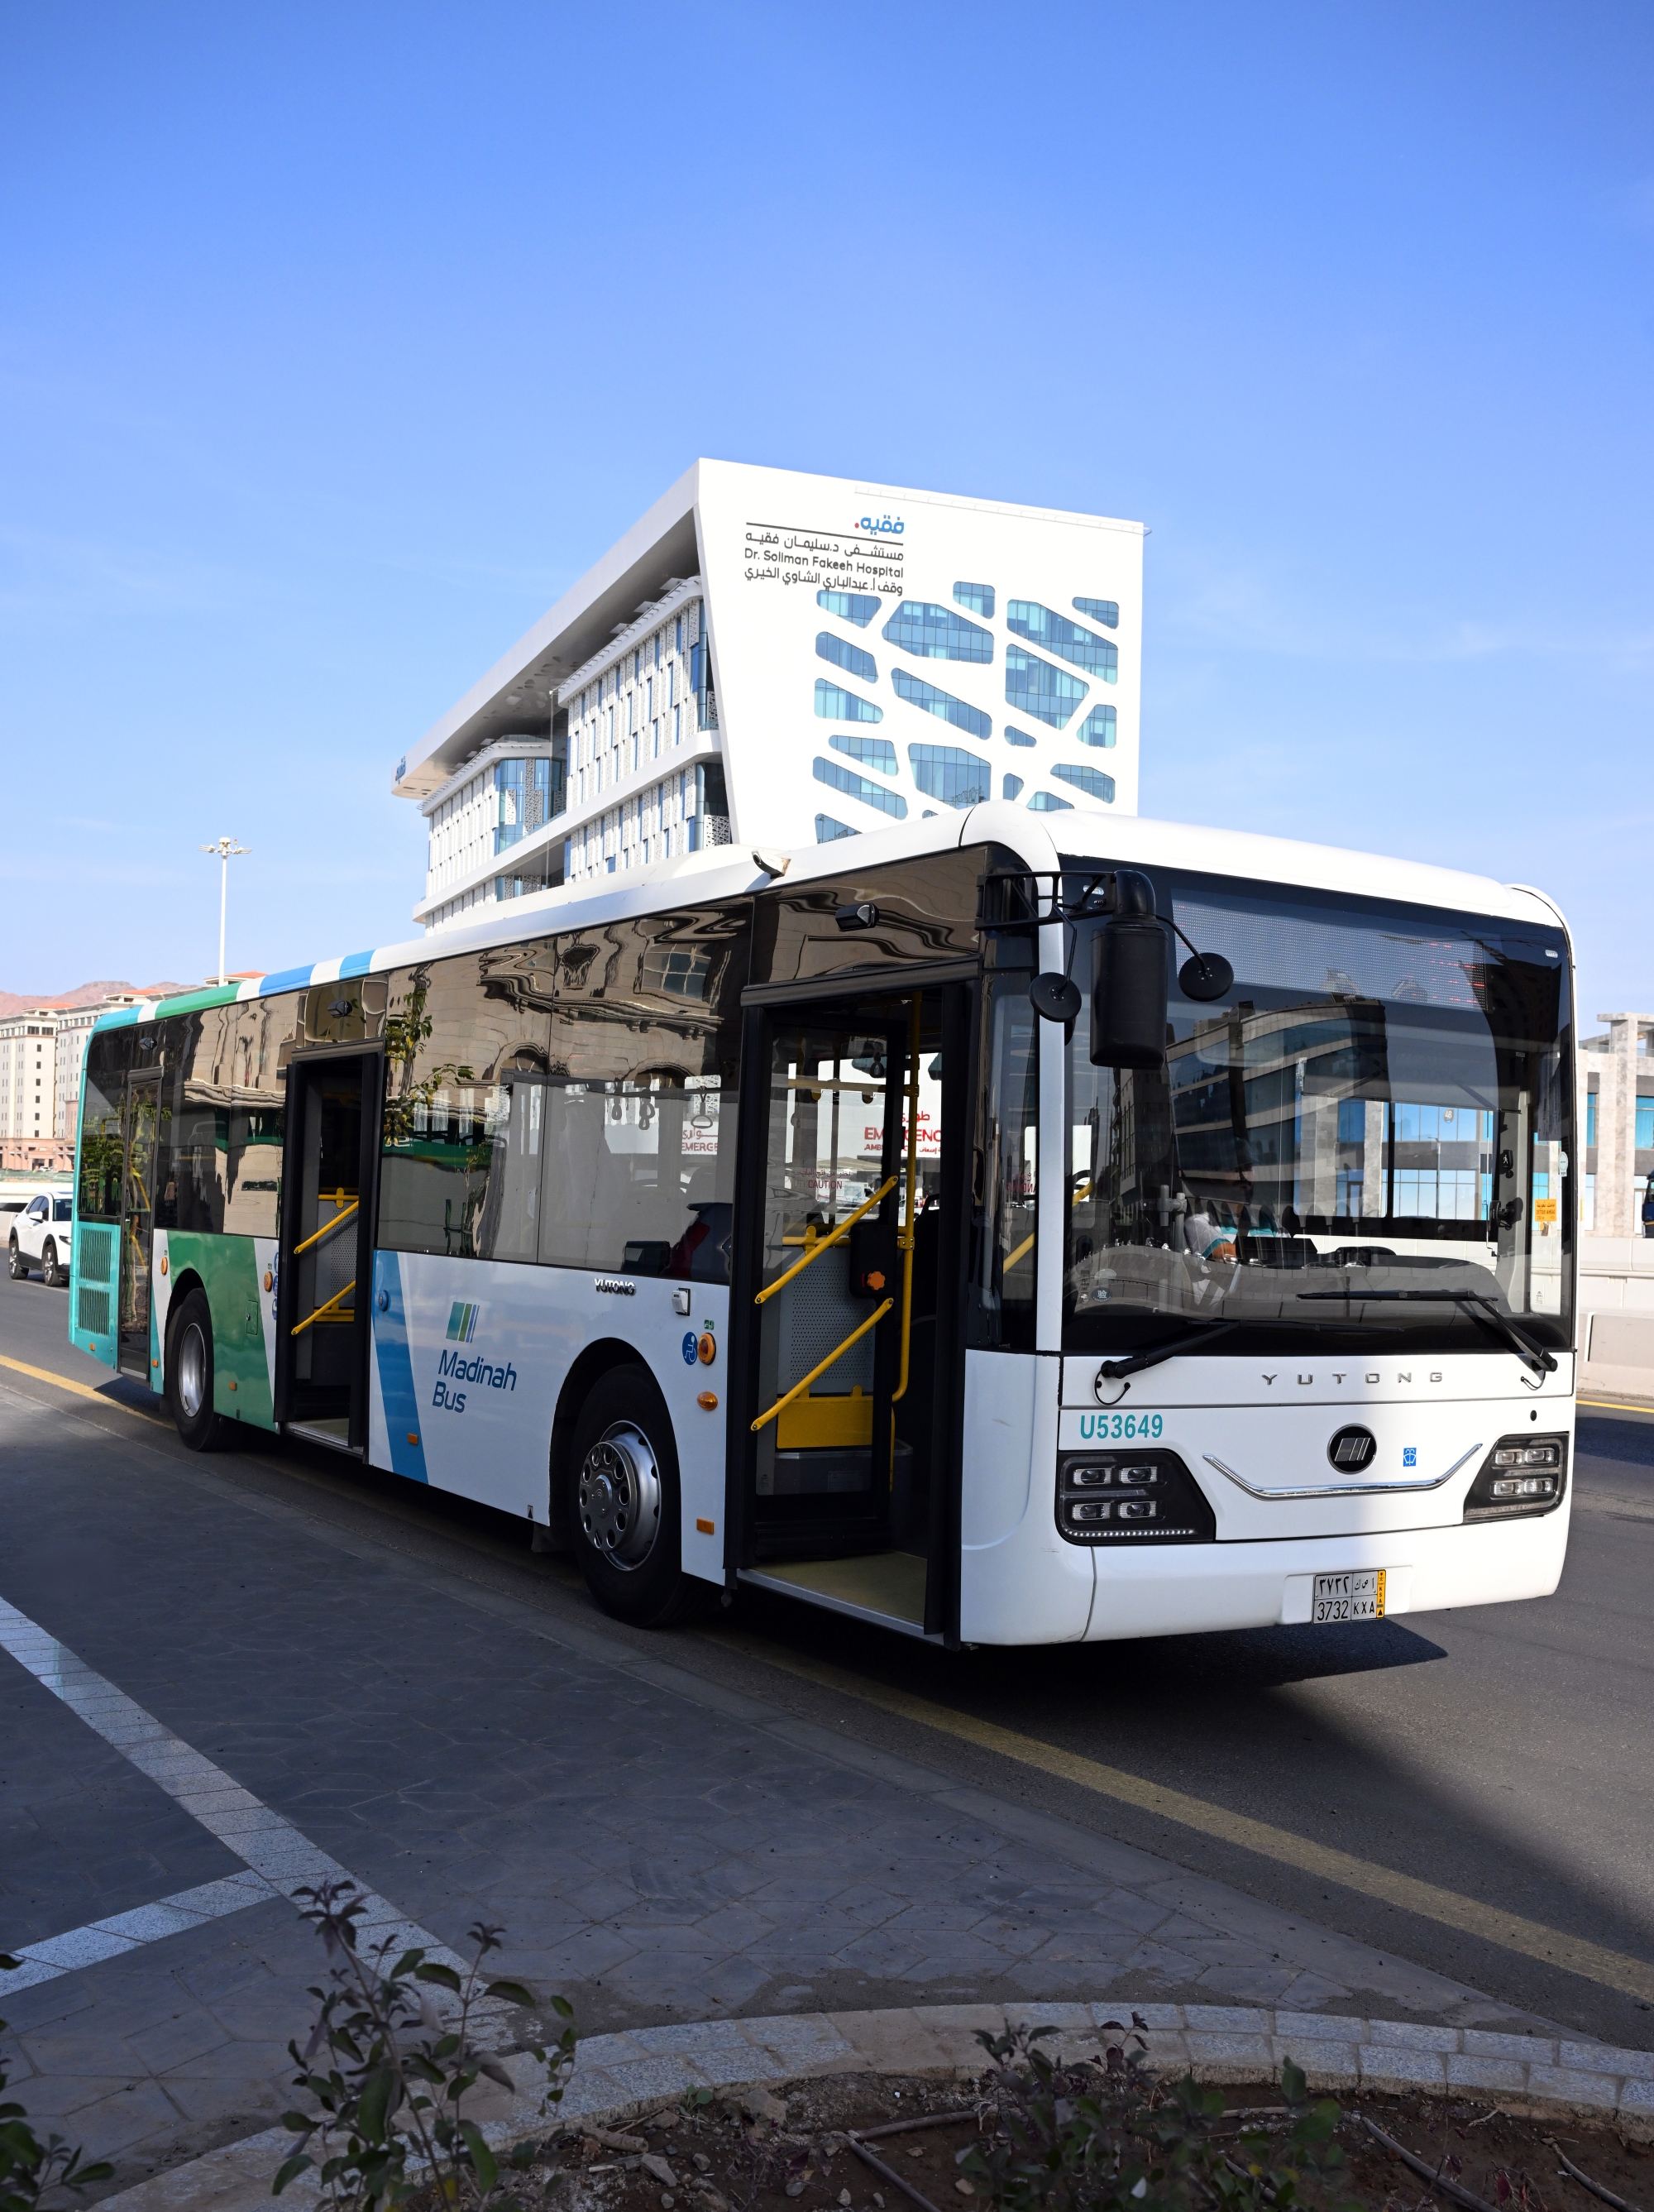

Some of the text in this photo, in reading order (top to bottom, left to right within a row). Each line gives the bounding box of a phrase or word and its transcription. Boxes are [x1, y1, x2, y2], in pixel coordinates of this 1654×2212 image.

[746, 532, 779, 545] فقيه
[844, 544, 903, 561] مستشفى
[745, 548, 760, 560] Dr.
[813, 556, 853, 572] Fakeeh
[857, 562, 903, 578] Hospital
[744, 567, 779, 581] الخيري
[782, 570, 820, 586] الشاوي
[877, 581, 903, 596] وقف
[681, 1142, 718, 1151] EMERGE
[808, 1180, 843, 1189] CAUTION
[595, 1278, 636, 1296] YUTONG
[438, 1349, 517, 1391] Madinah
[1261, 1372, 1443, 1386] YUTONG
[432, 1381, 467, 1413] Bus
[1080, 1414, 1163, 1439] U53649
[1317, 1600, 1349, 1621] 3732
